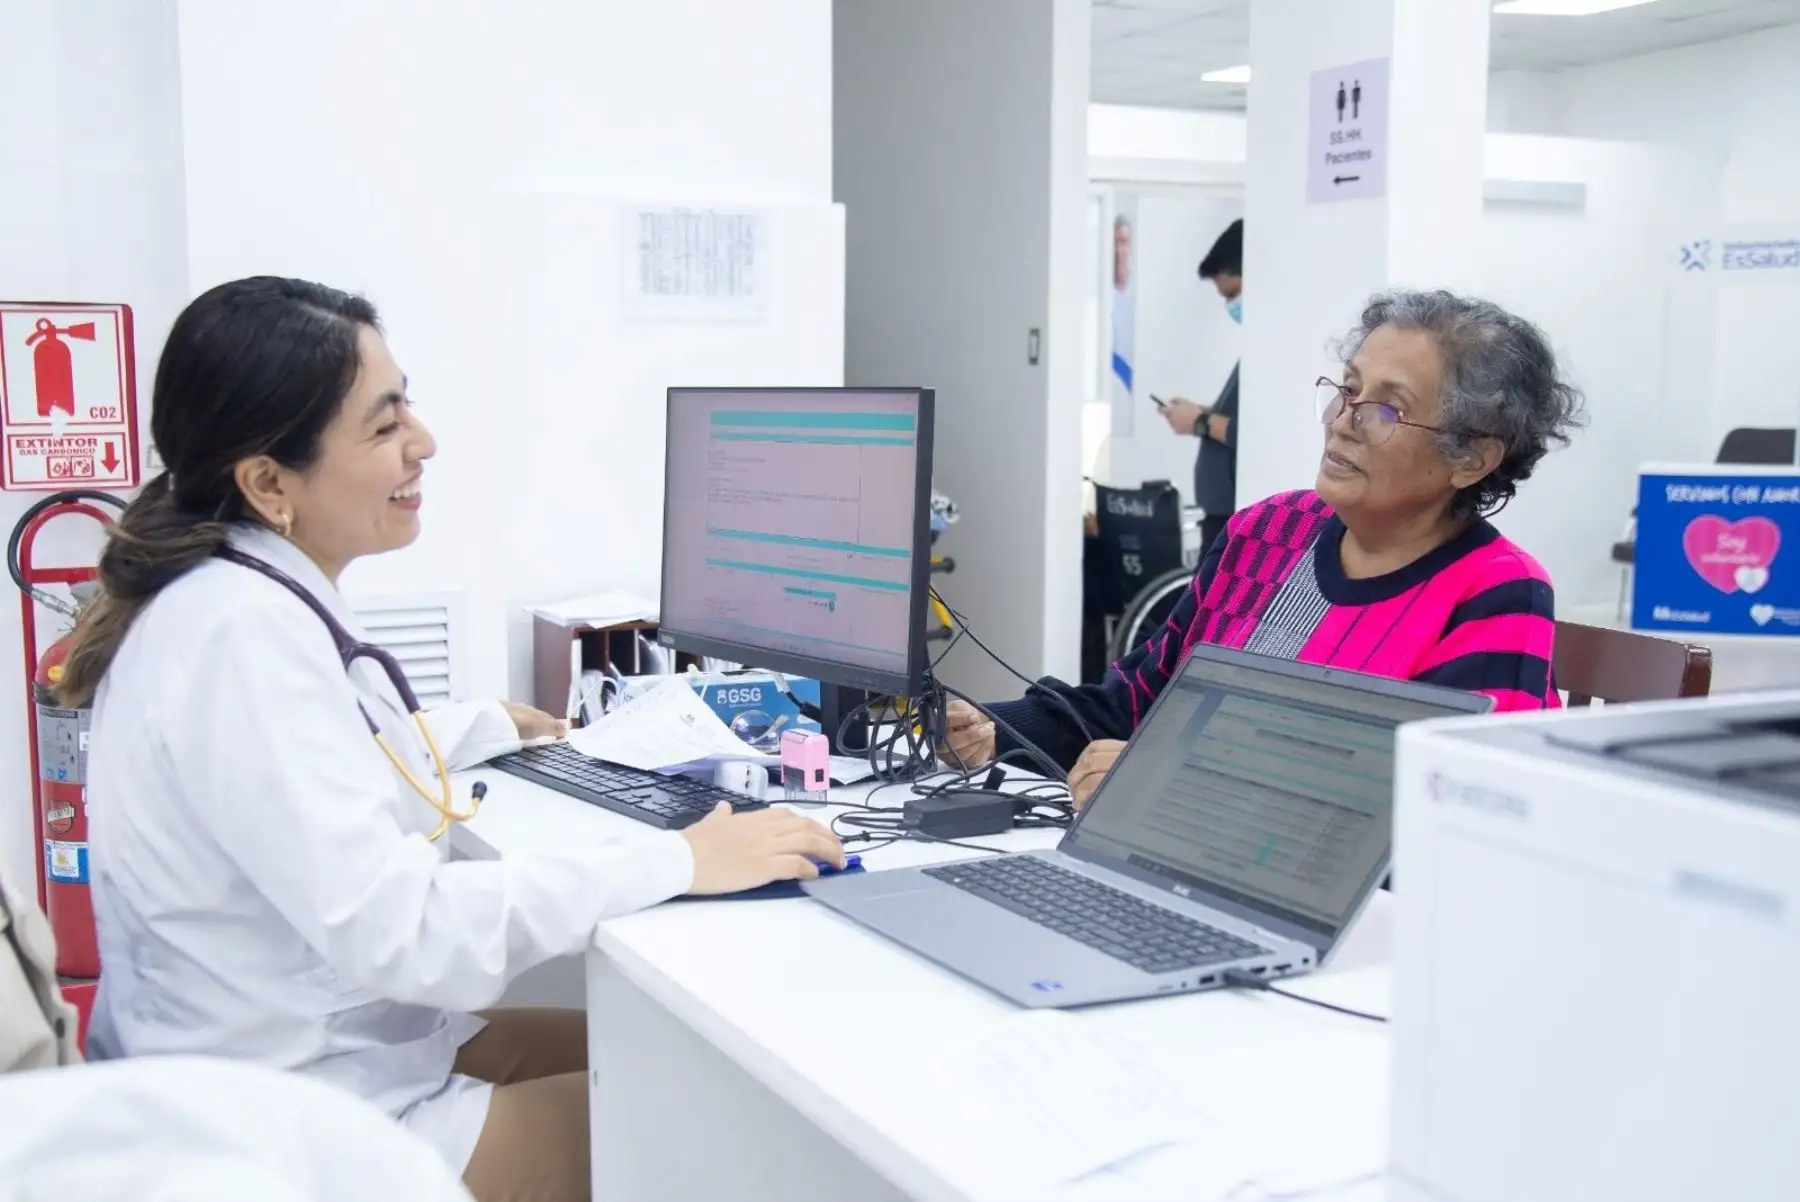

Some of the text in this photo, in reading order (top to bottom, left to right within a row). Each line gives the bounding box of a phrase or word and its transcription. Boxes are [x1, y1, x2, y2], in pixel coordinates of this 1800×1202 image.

[1325, 150, 1372, 166] Pacientes
[90, 407, 116, 418] CO2
[16, 438, 97, 448] EXTINTOR
[728, 687, 762, 703] GSG
